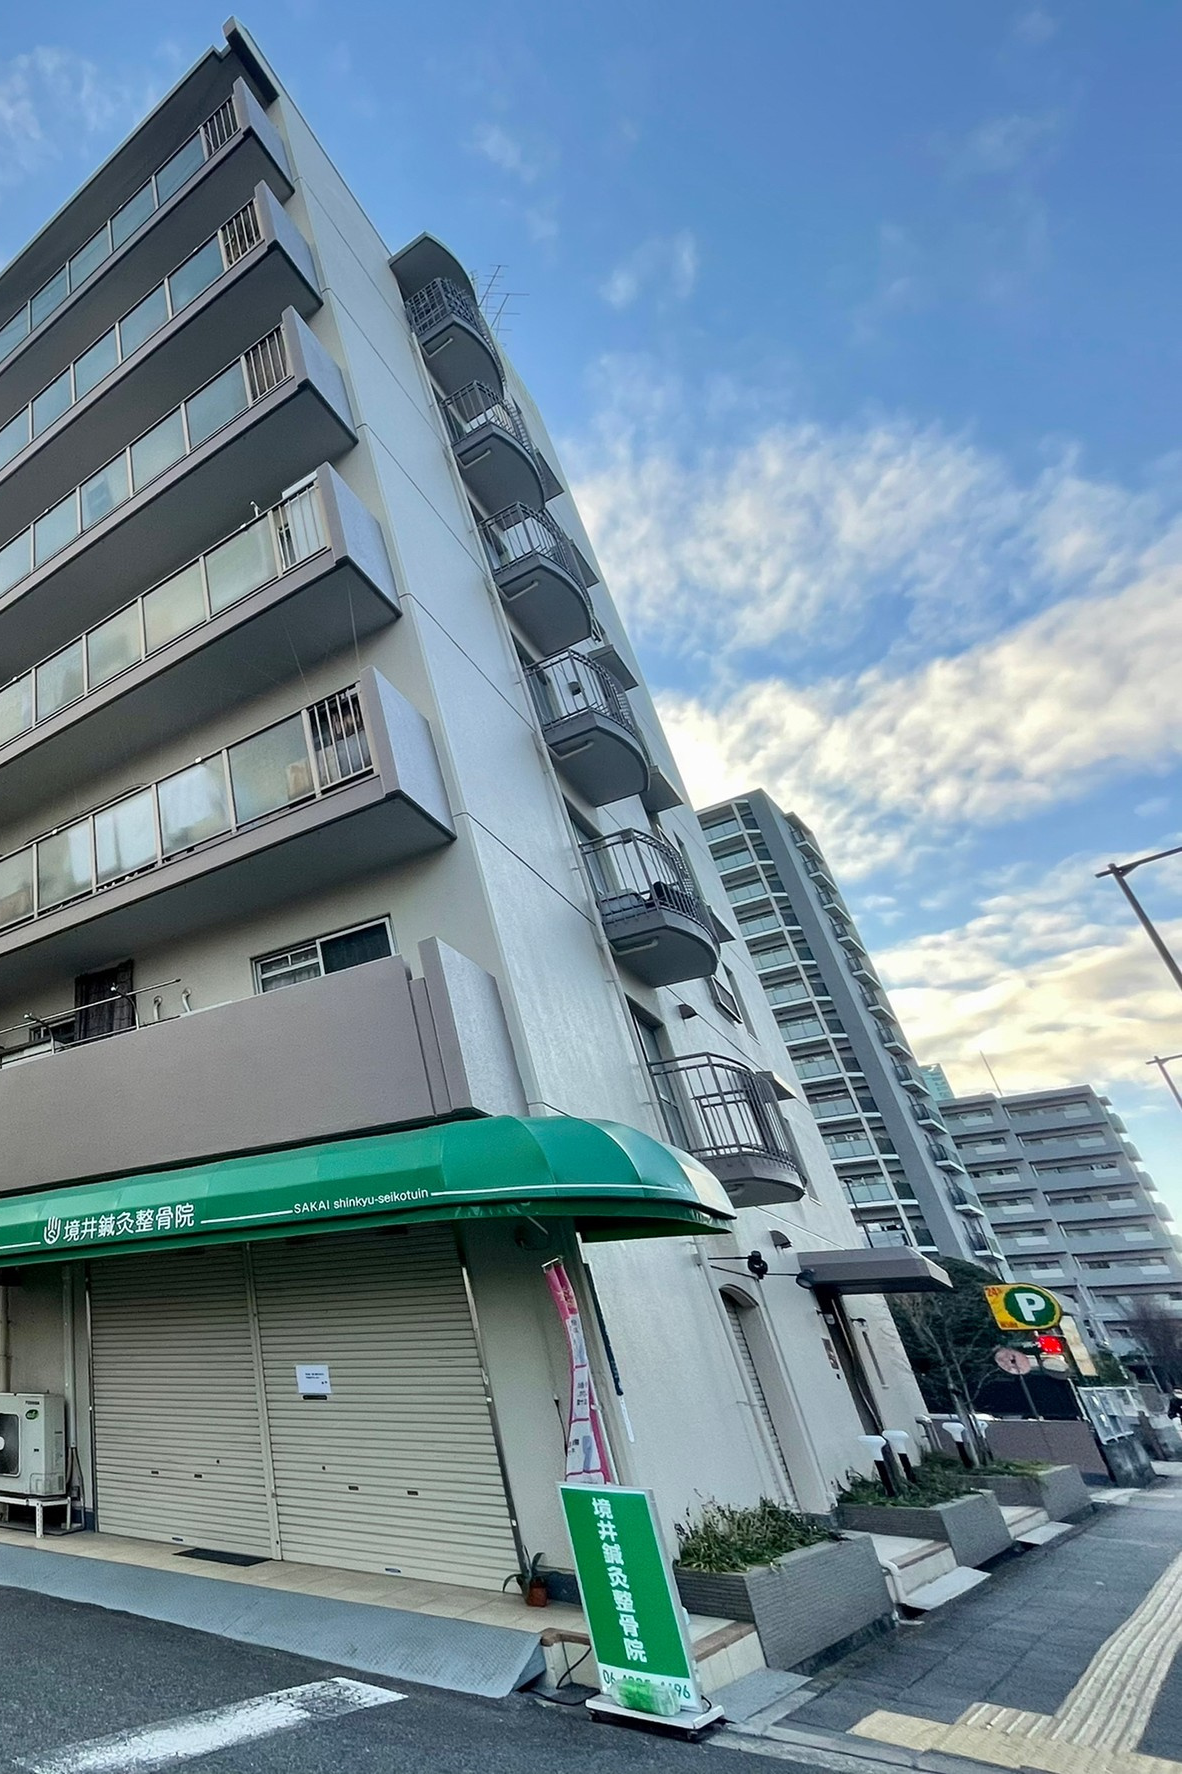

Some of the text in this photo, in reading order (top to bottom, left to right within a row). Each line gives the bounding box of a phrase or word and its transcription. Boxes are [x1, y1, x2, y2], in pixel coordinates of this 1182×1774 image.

[293, 1187, 429, 1215] SAKAI shinkyu-seikotuin
[63, 1202, 195, 1243] 境井鍼灸整骨院
[1014, 1292, 1046, 1322] P
[592, 1497, 648, 1663] 境井鍼灸整骨院
